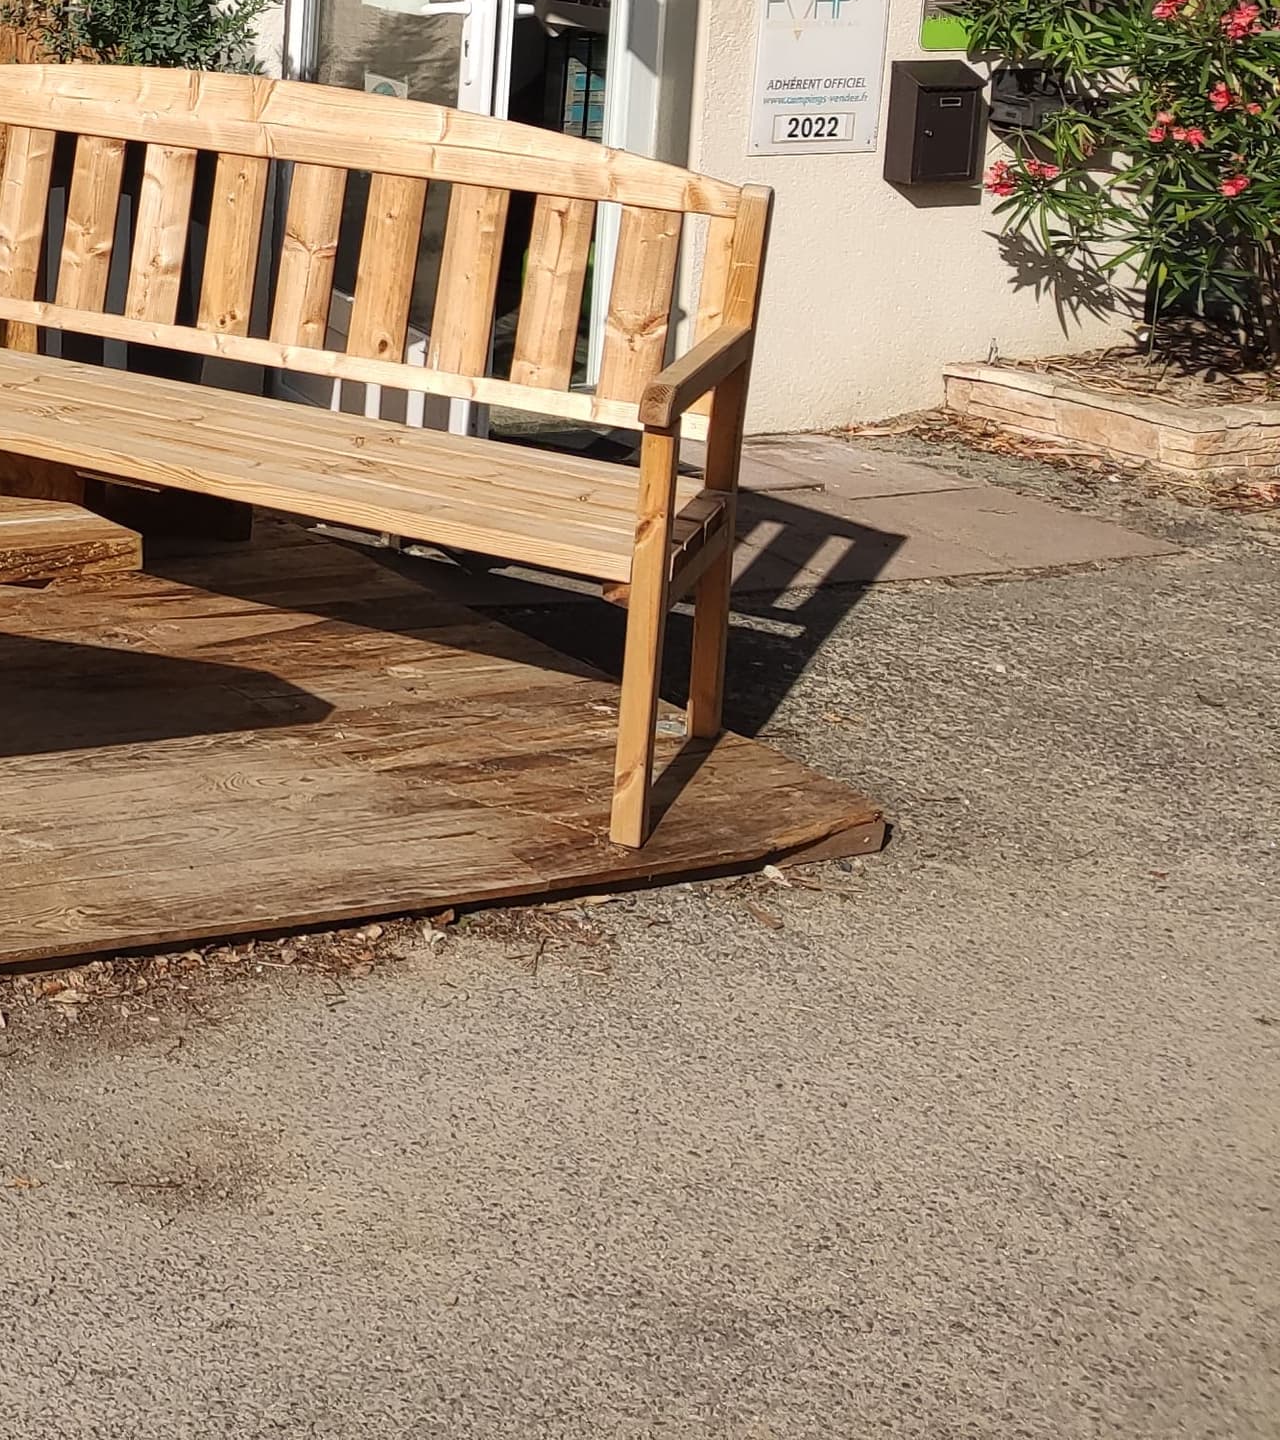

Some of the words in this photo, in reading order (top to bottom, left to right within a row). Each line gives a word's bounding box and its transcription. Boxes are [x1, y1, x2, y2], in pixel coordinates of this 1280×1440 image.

[766, 76, 823, 90] ADHÉRENT
[824, 77, 866, 89] OFFICIEL
[787, 117, 839, 138] 2022
